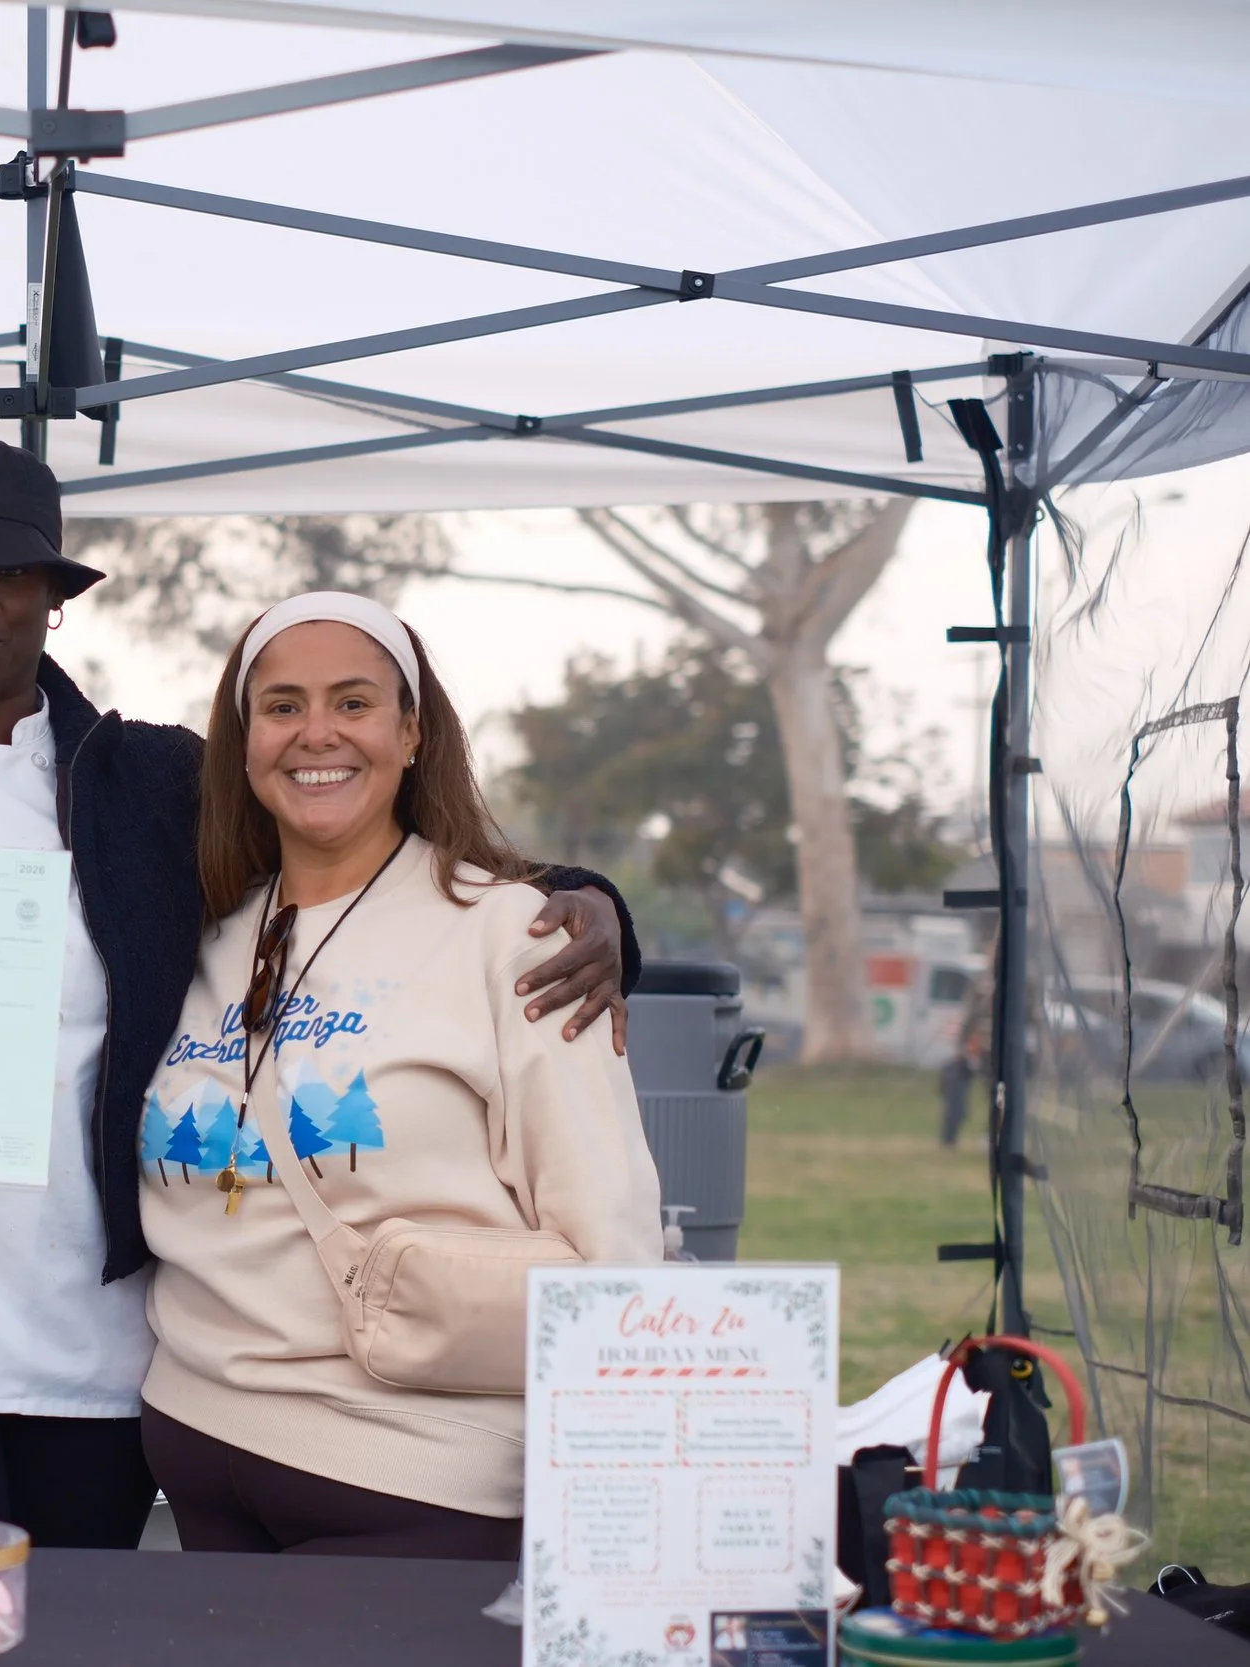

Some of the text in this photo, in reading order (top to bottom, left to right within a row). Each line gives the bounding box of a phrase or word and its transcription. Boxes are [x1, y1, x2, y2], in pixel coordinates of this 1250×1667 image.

[19, 864, 46, 876] 2026
[221, 990, 320, 1038] Wter
[166, 1011, 368, 1066] Extraganza
[618, 1294, 700, 1338] Cater
[597, 1346, 762, 1363] HOLIDAY MENU
